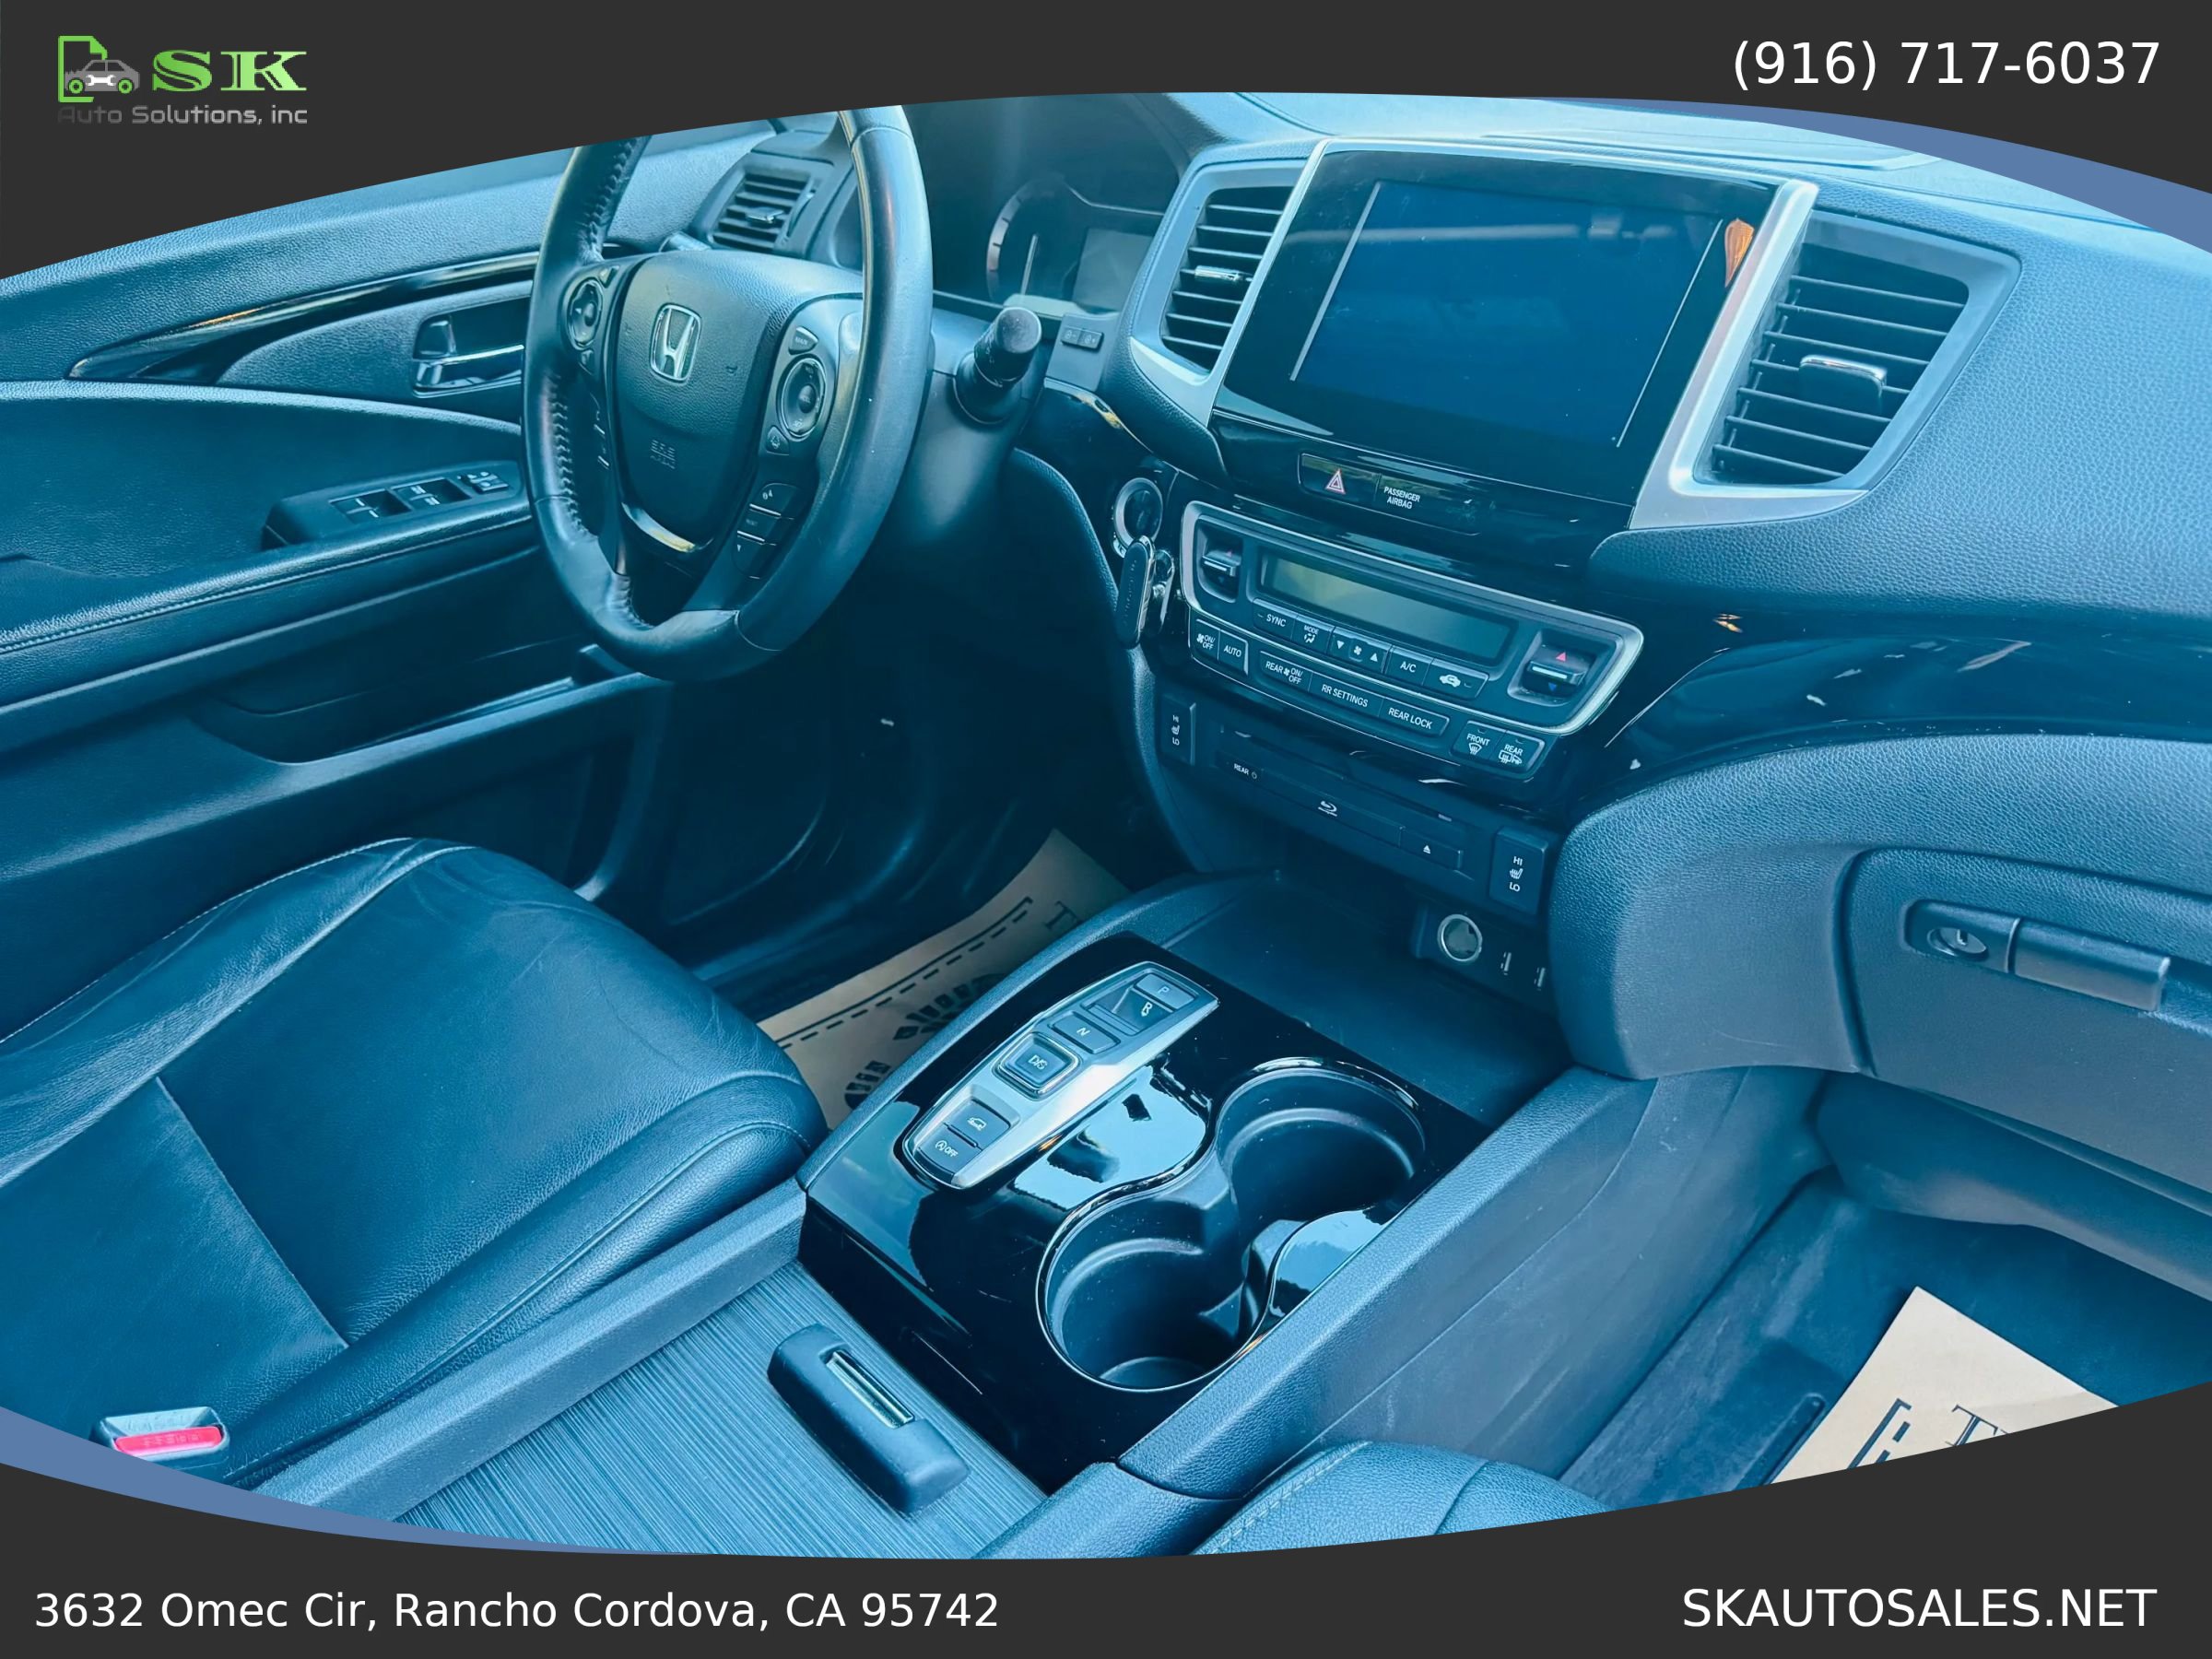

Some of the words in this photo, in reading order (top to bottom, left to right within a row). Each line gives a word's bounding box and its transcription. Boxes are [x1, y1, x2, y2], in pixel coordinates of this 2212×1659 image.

[1383, 486, 1420, 502] PASSENGER
[1386, 496, 1413, 510] AIRBAG
[1266, 614, 1287, 627] SYNC
[1303, 625, 1319, 635] MODE
[1202, 641, 1215, 650] OFF
[1223, 645, 1242, 657] AUTO
[1265, 661, 1283, 674] REAR
[1400, 661, 1417, 673] A/C
[1288, 675, 1302, 685] OFF
[1321, 684, 1332, 694] RR
[1332, 688, 1369, 708] SETTINGS
[1388, 707, 1409, 722] REAR
[1410, 716, 1433, 730] LOCK
[1466, 733, 1490, 747] FRONT
[1504, 744, 1524, 756] REAR
[1233, 763, 1250, 775] REAR
[1512, 855, 1524, 866] HI
[1509, 881, 1521, 892] LO
[1157, 985, 1170, 994] P
[1143, 1001, 1153, 1012] R
[1076, 1027, 1091, 1037] N
[1028, 1053, 1048, 1070] D/S
[944, 1146, 959, 1158] OFF
